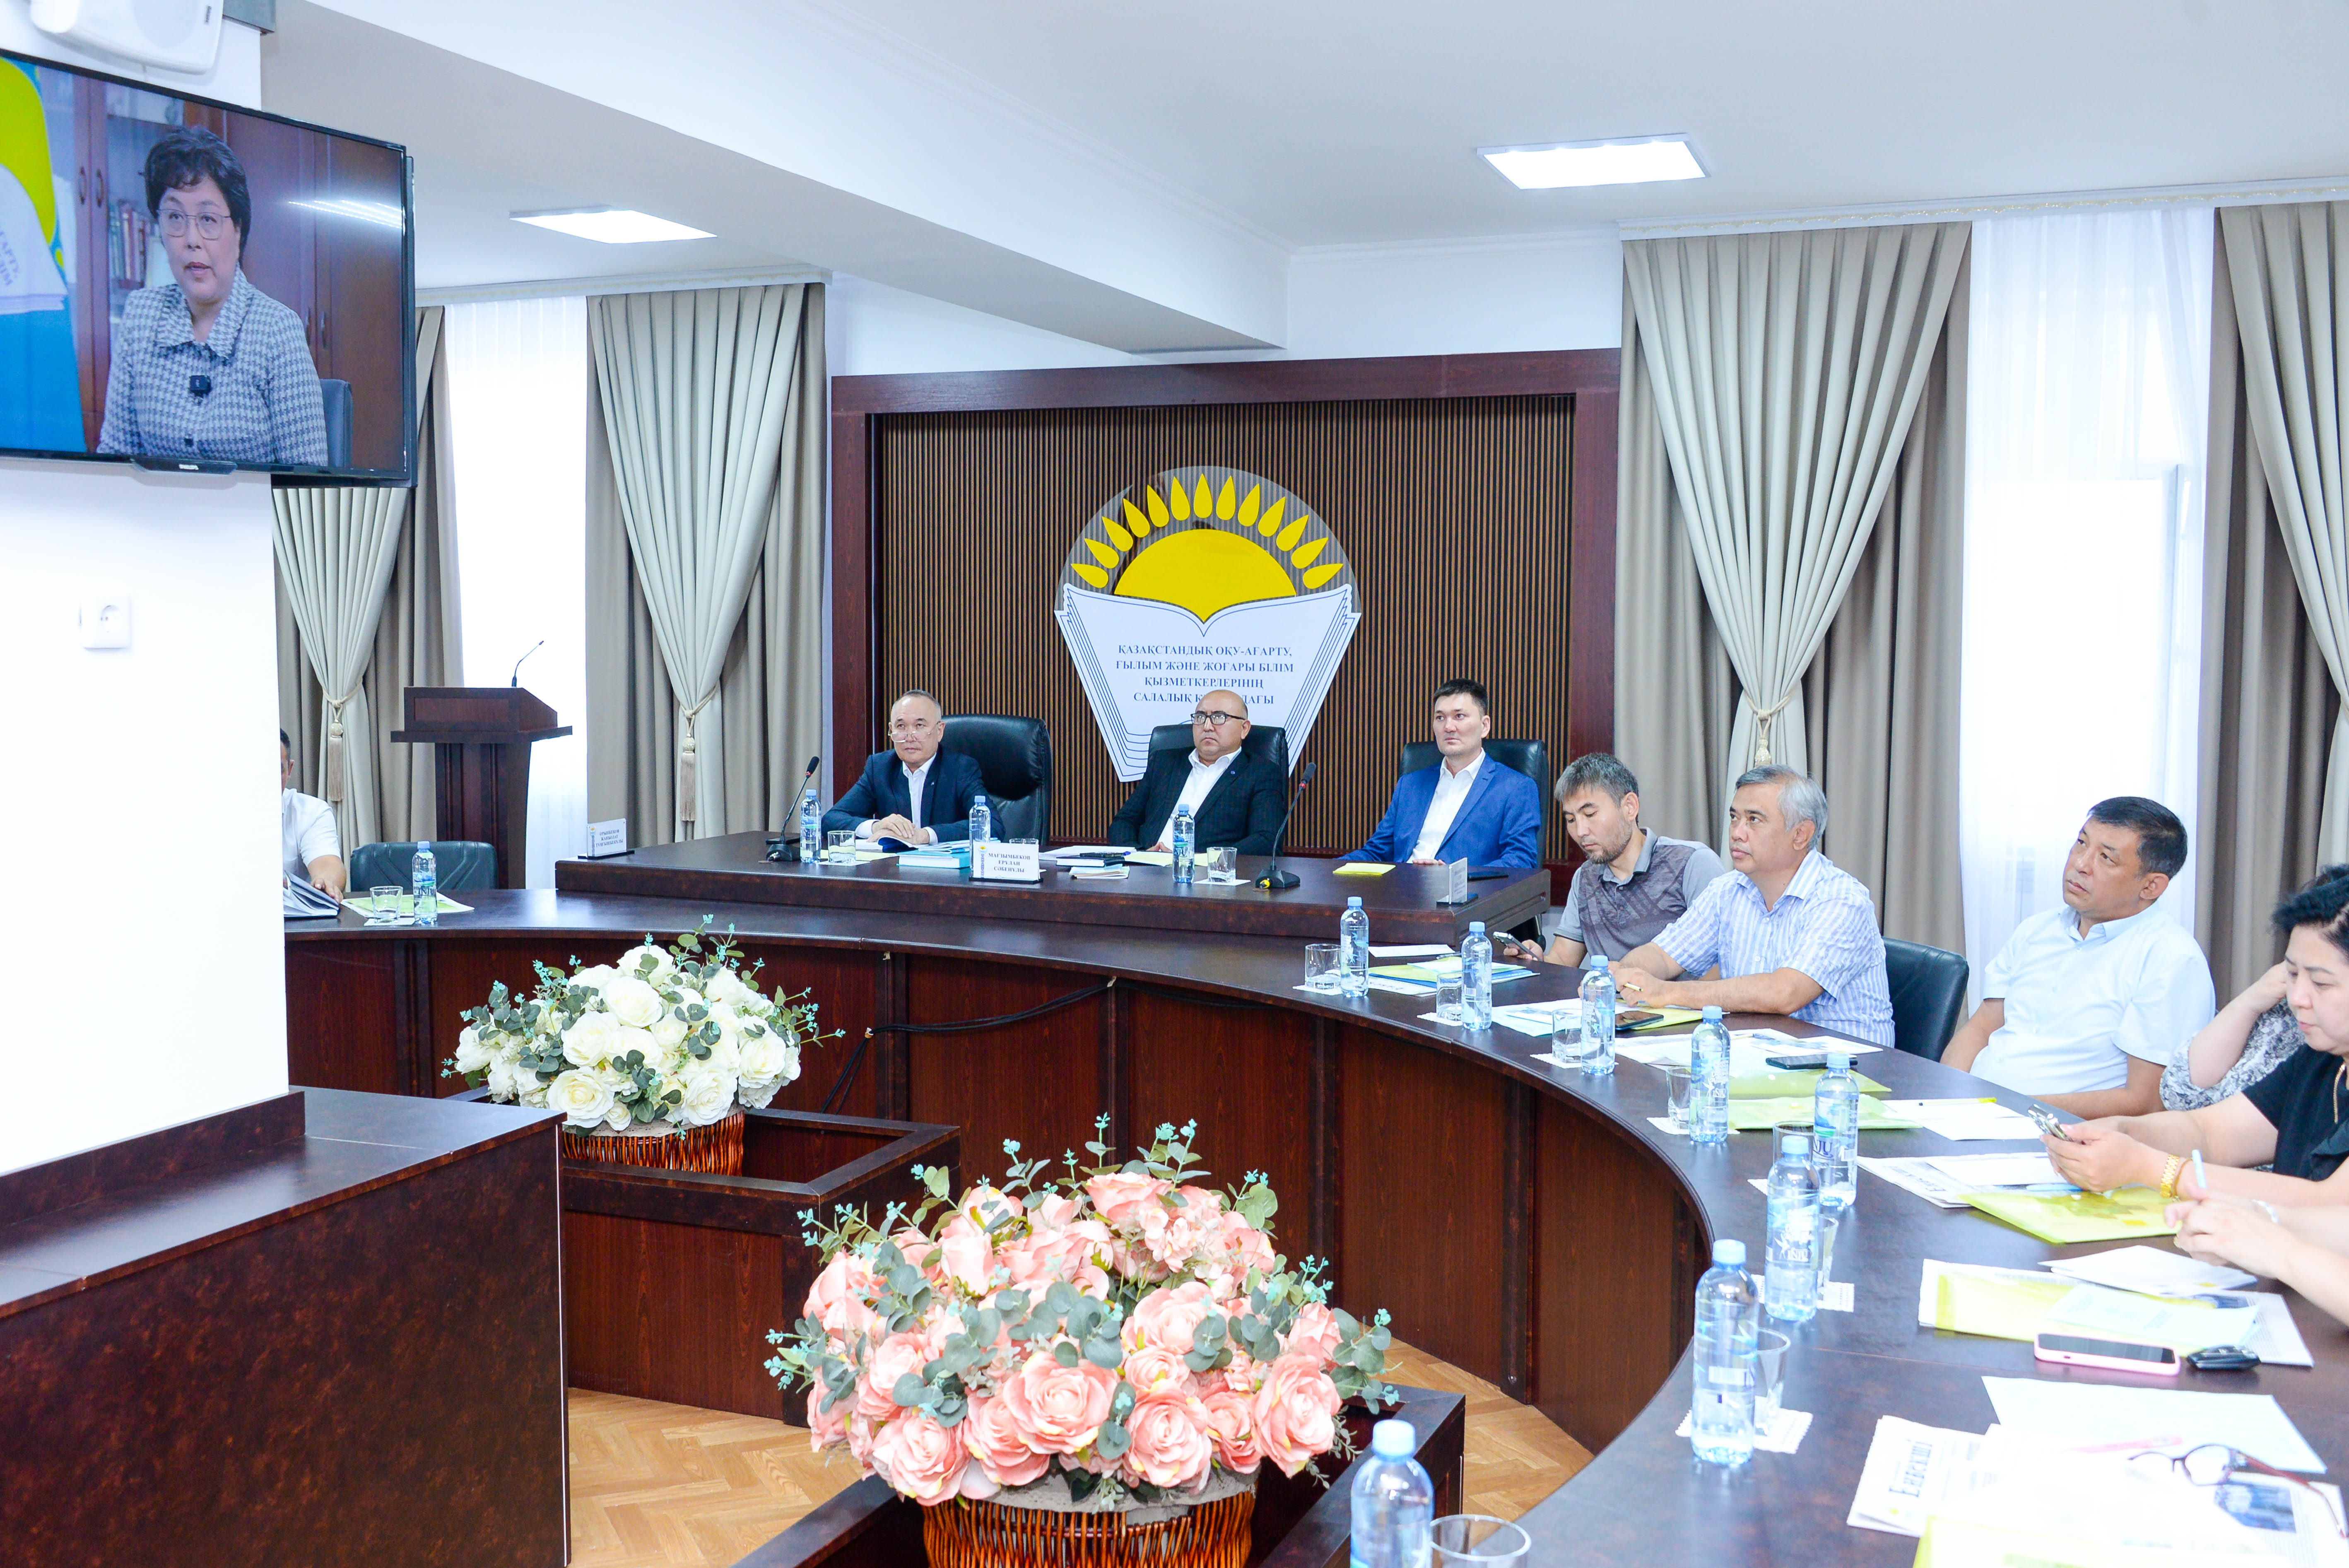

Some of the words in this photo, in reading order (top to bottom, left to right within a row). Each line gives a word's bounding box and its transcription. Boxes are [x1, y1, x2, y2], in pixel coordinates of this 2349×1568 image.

[1118, 645, 1213, 656] ҚАЗАҚСТАНДЫҚ
[1216, 646, 1292, 657] ОҚУ-АҒАРТУ,
[1116, 661, 1162, 670] ҒЫЛЫМ
[1165, 662, 1200, 671] ЖӘНЕ
[1203, 662, 1255, 671] ЖОҒАРЫ
[1259, 663, 1294, 672] БІЛІМ
[1145, 677, 1264, 689] ҚЫЗМЕТКЕРЛЕРІНІҢ
[1134, 692, 1192, 703] САЛАЛЫҚ
[1813, 1136, 1833, 1155] NJU
